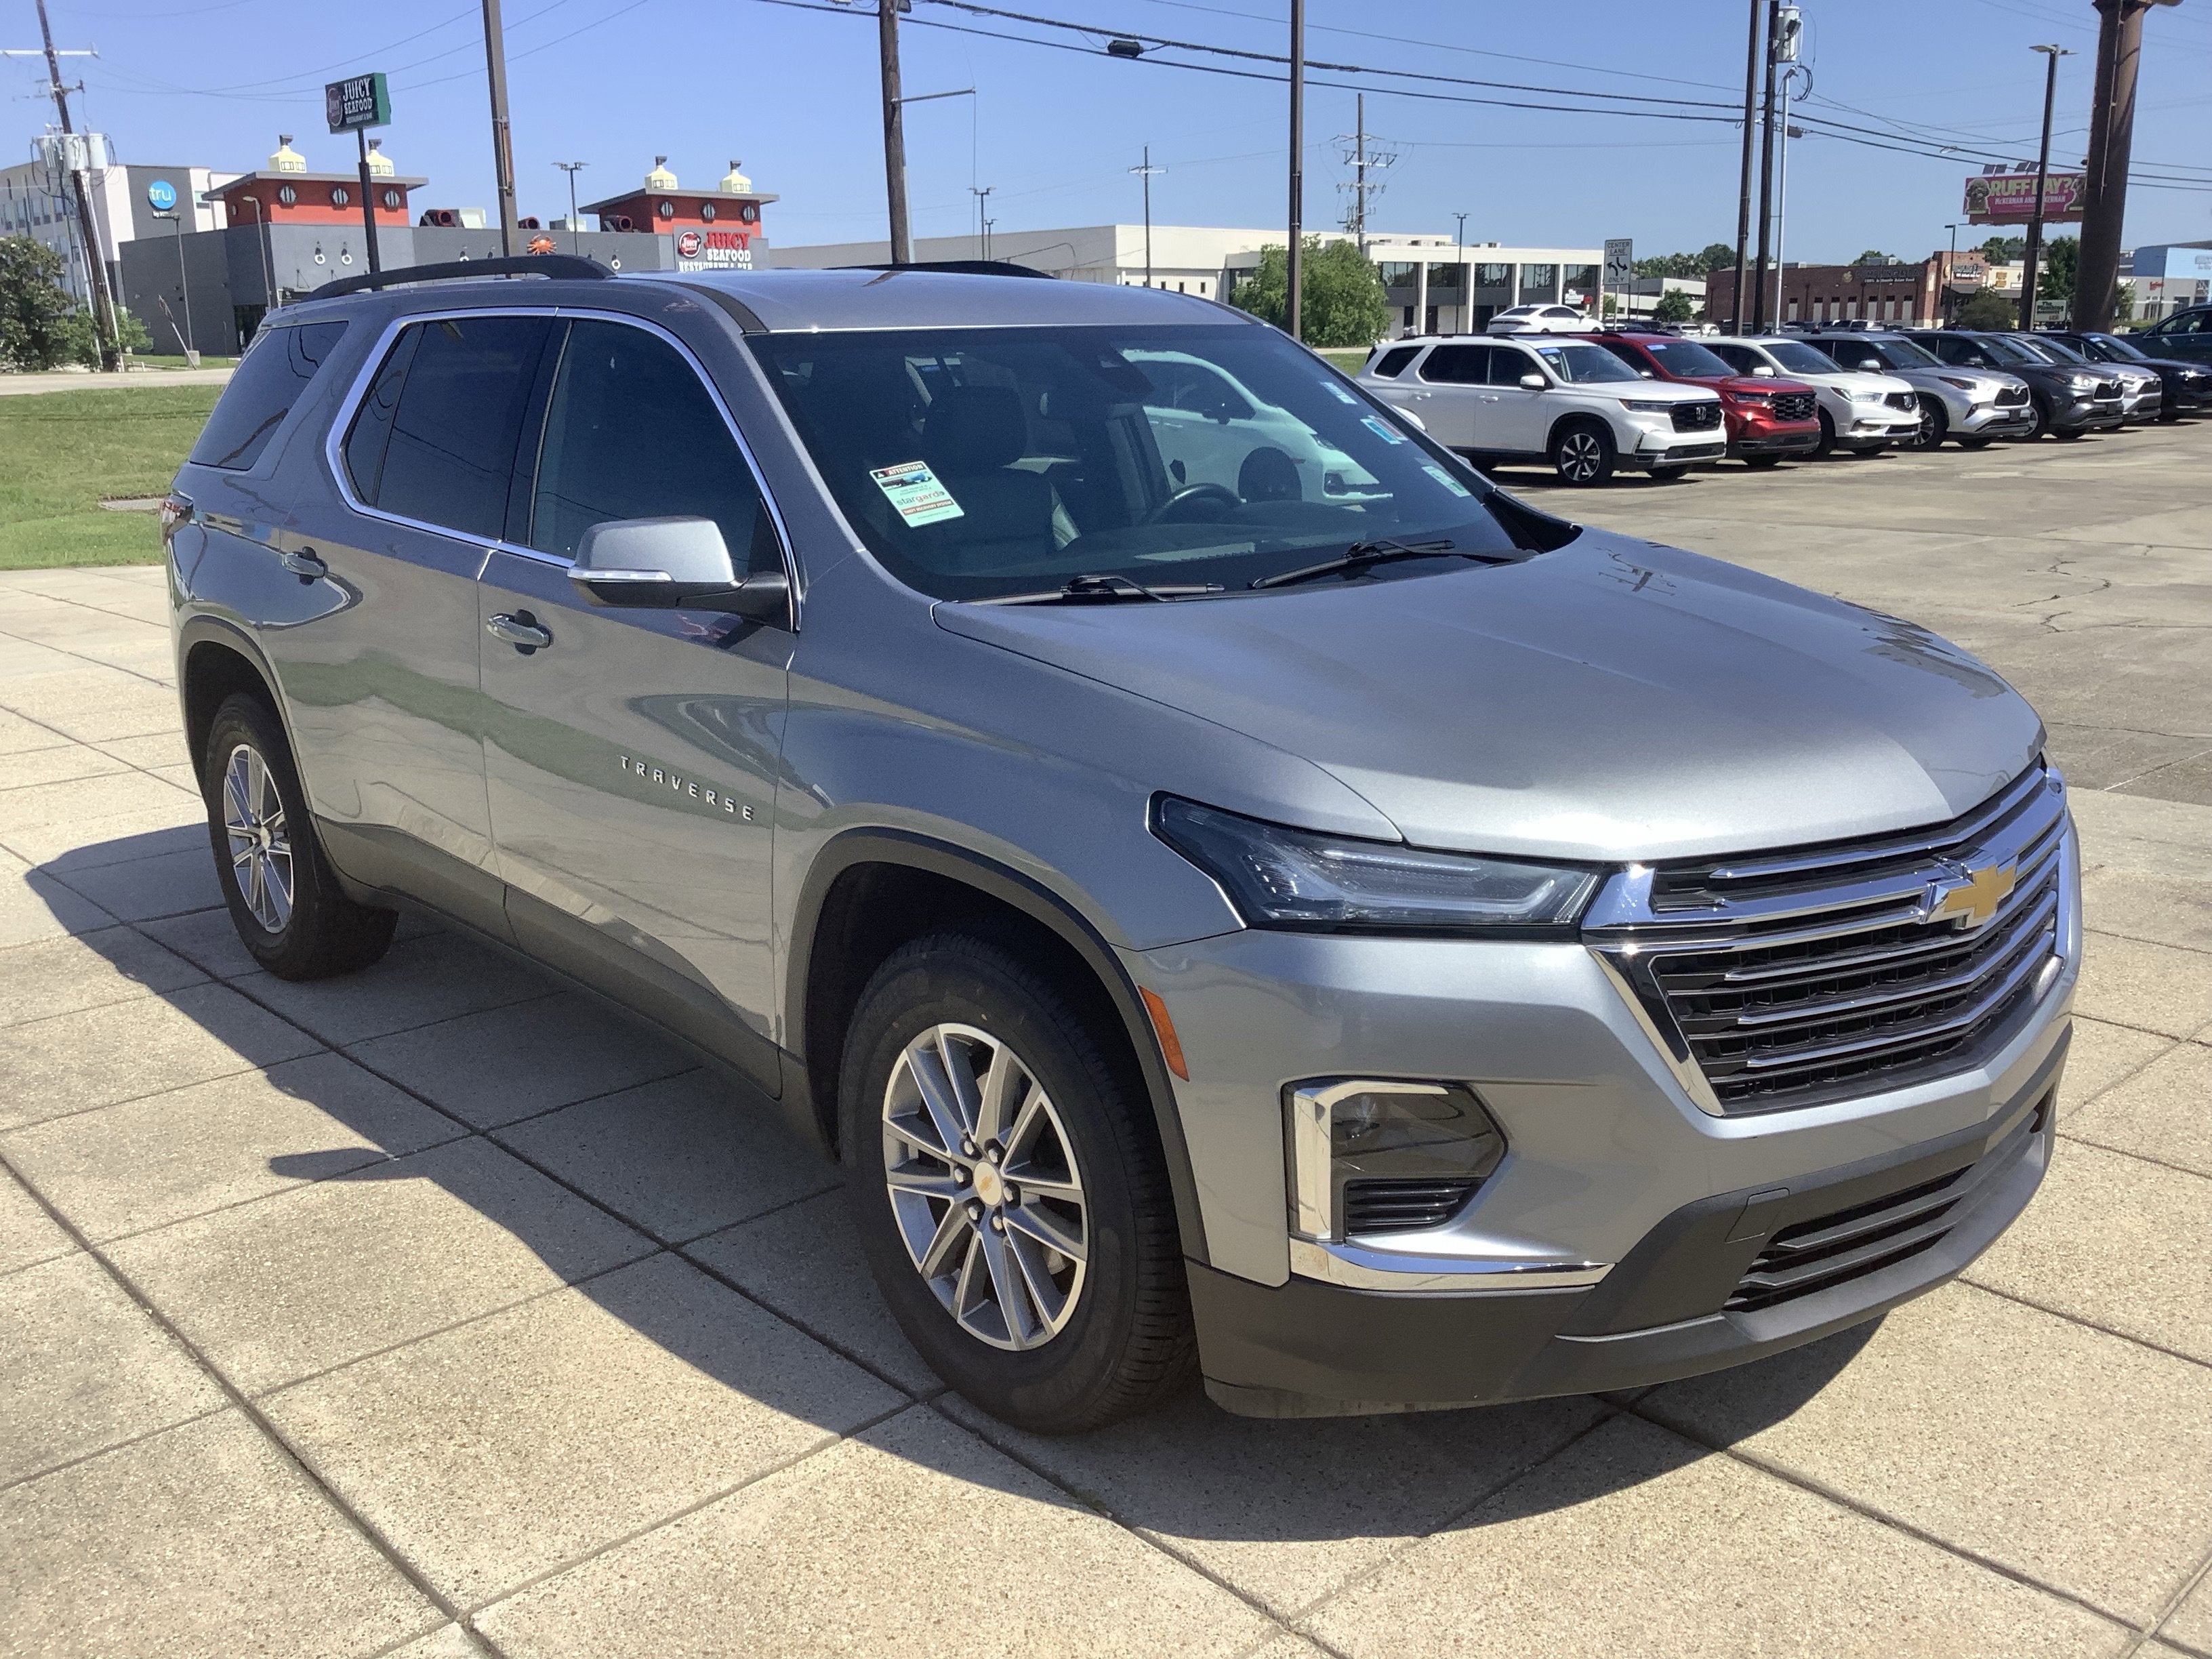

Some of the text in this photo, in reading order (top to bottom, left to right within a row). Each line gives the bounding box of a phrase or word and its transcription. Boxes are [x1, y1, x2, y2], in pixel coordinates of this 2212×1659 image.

[343, 78, 371, 102] JUICY
[344, 97, 372, 115] SEAFOOD
[149, 187, 172, 201] tru
[1990, 178, 2030, 196] RUFF
[704, 232, 750, 249] JUICY
[707, 249, 751, 262] SEAFOOD
[888, 464, 924, 476] ATTENTION
[621, 755, 754, 821] TRAVERSE
